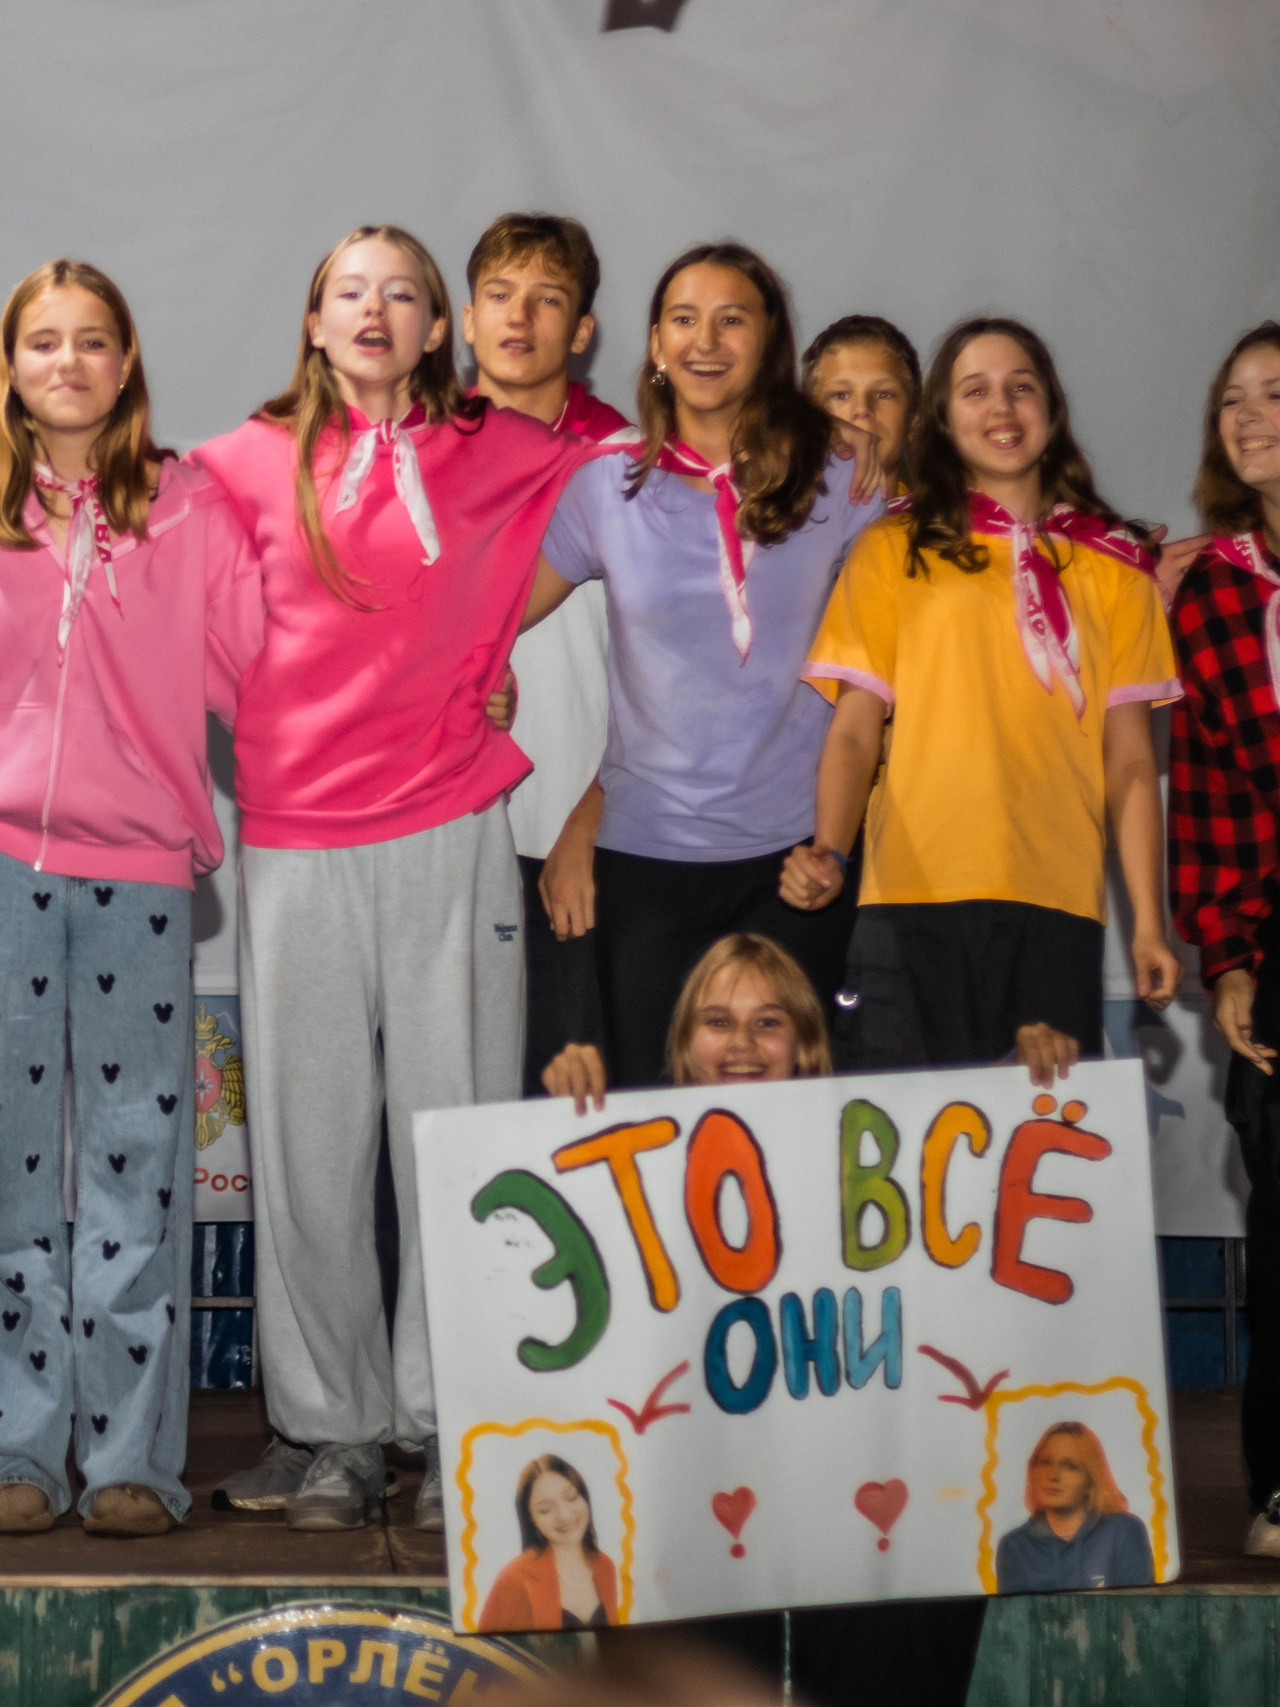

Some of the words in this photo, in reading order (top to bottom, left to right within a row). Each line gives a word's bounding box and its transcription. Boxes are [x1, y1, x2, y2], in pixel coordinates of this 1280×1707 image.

[470, 1108, 782, 1372] ЭТО
[839, 1093, 1113, 1305] ВСЁ
[704, 1286, 903, 1415] ОНИ
